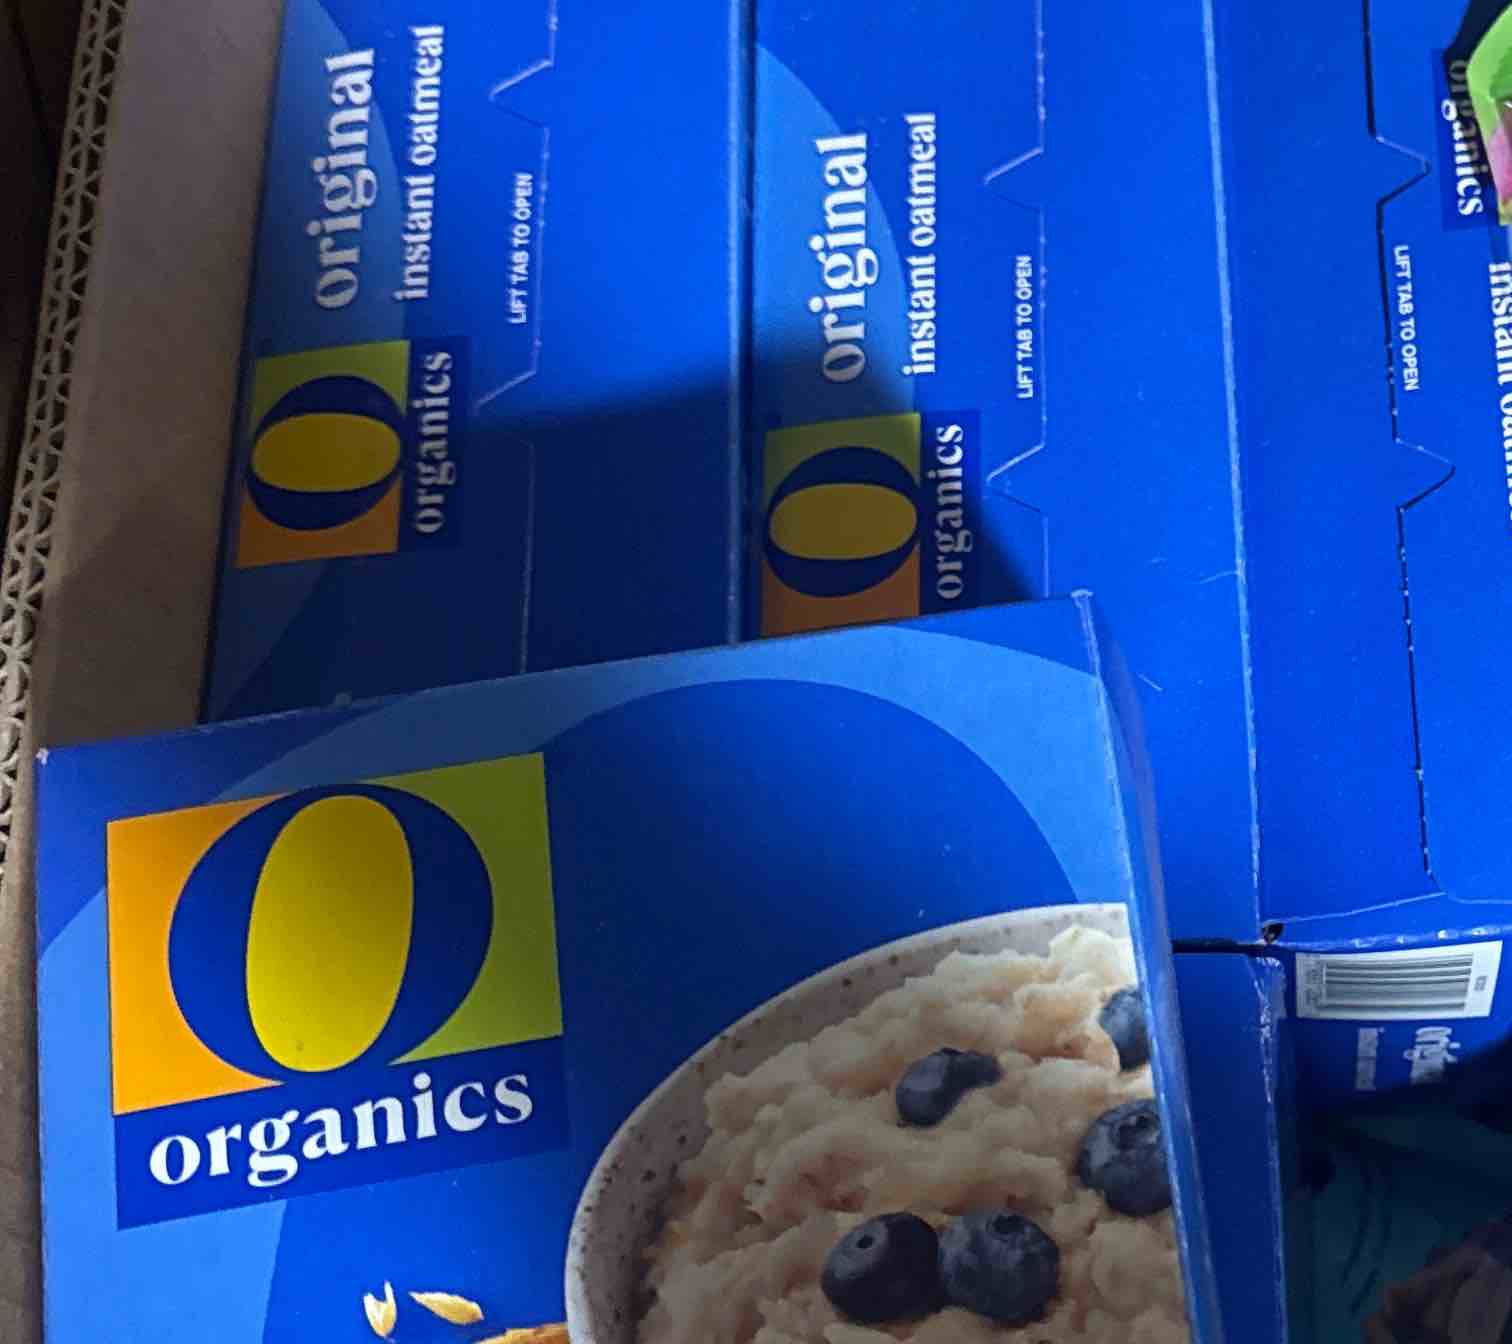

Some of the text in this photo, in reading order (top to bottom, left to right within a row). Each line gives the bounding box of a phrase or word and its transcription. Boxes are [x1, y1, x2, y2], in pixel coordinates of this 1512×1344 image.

[307, 47, 378, 309] original
[394, 25, 445, 301] instant oatmeal
[508, 173, 533, 325] LIFT TAB TO OPEN
[903, 111, 936, 378] instant oatmeal
[809, 131, 878, 384] original
[1017, 255, 1034, 400] LIFT TAB TO OPEN
[1392, 244, 1419, 392] LIFT TAB TO OPEN
[410, 352, 456, 534] organics
[933, 423, 973, 601] organics
[149, 1073, 533, 1188] organics
